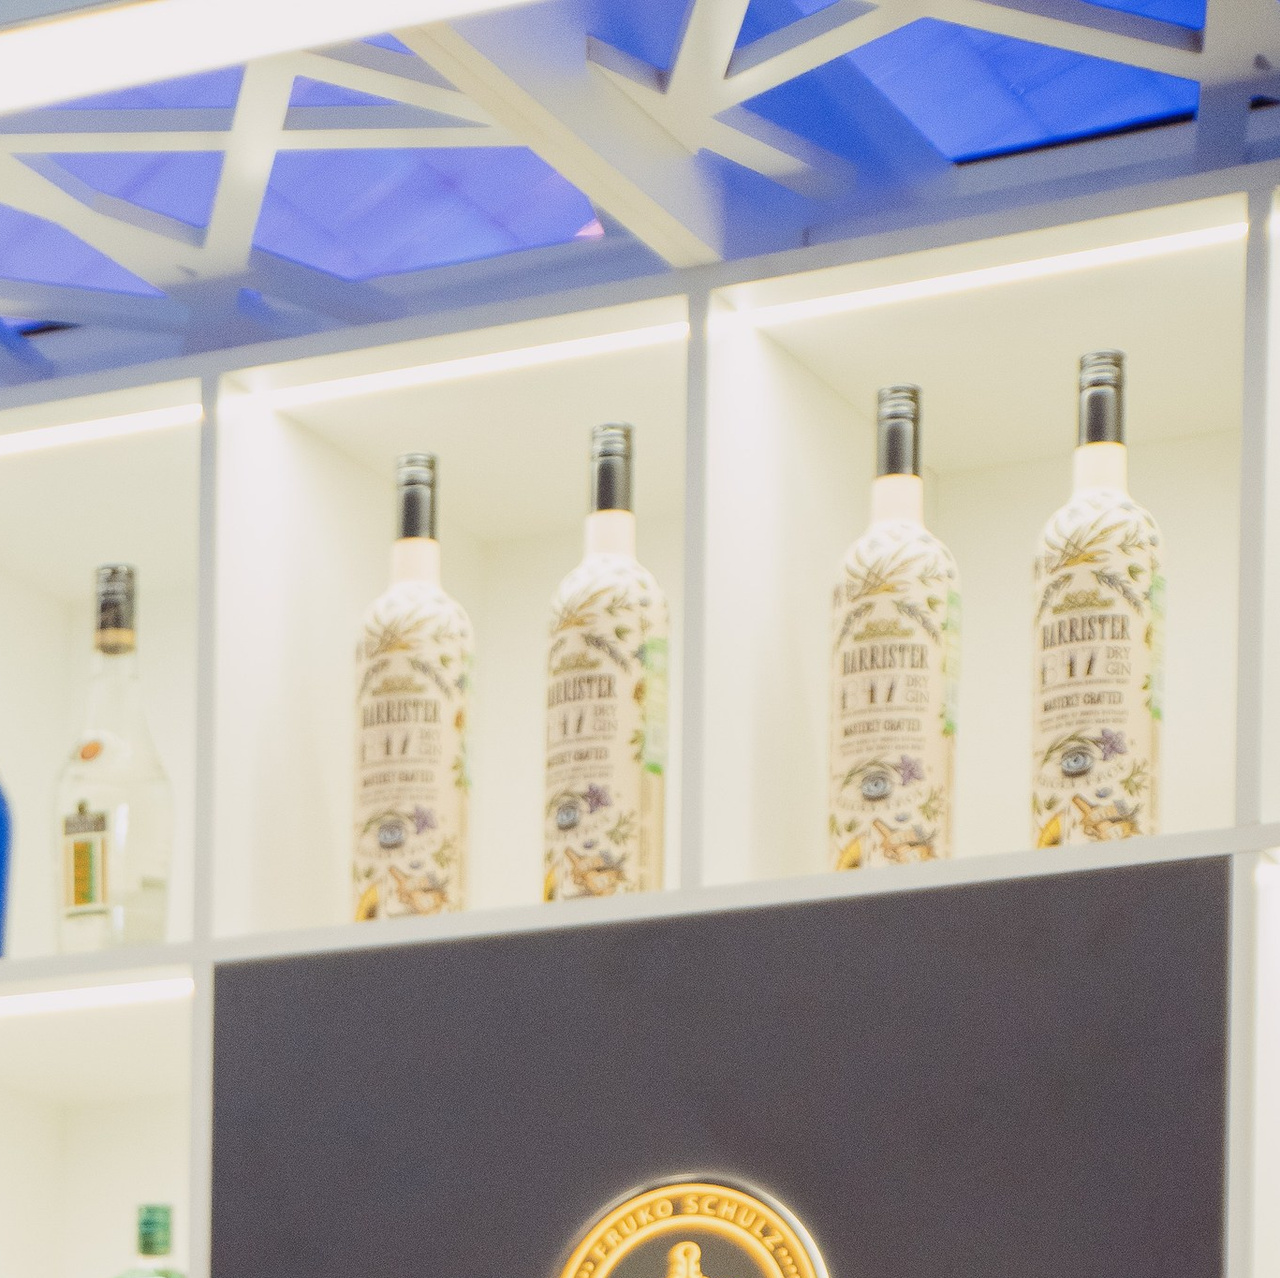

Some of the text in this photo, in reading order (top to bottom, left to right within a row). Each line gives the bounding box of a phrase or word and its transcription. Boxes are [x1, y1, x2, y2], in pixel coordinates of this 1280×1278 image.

[1043, 615, 1130, 647] BARRISTER
[843, 644, 929, 675] BARRISTER
[1106, 646, 1131, 660] DRY
[1105, 662, 1132, 676] GIN
[906, 675, 930, 688] DRY
[905, 690, 931, 704] GIN
[363, 700, 439, 728] BARRISTER
[593, 1194, 782, 1259] FRUKO SCHULZ
